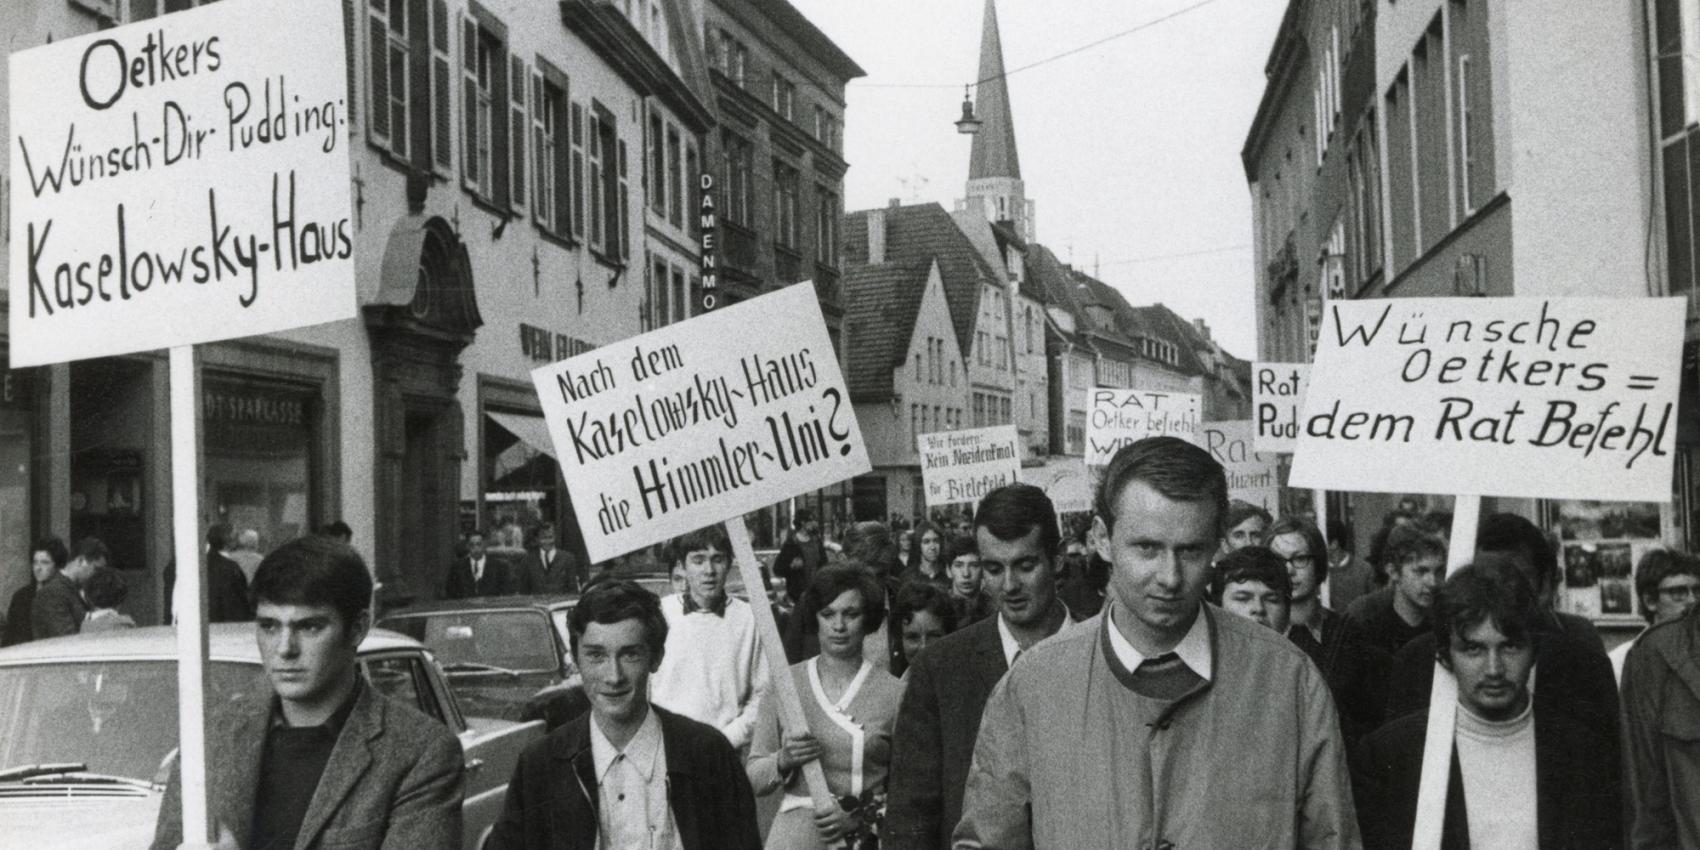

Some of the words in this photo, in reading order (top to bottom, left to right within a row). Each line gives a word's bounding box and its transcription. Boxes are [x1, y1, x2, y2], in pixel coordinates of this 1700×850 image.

[79, 29, 221, 111] Oetkers
[223, 74, 347, 154] Pudding:
[28, 170, 353, 319] Kaselowsky-Haus
[1332, 302, 1597, 353] Wünsche
[556, 359, 617, 404] Nach
[631, 343, 685, 382] dem
[1258, 368, 1300, 396] Rat
[1401, 349, 1609, 391] Oetkers
[1627, 374, 1660, 391] =
[566, 347, 818, 465] Kaselowsky-Haus
[1093, 408, 1140, 430] Oetker
[1258, 402, 1300, 439] Pud
[1305, 399, 1415, 443] dem
[1434, 396, 1524, 445] Rat
[1528, 400, 1673, 469] Befehl
[597, 493, 631, 536] die
[632, 386, 852, 520] Himmler-Uni?
[926, 451, 949, 469] Kein
